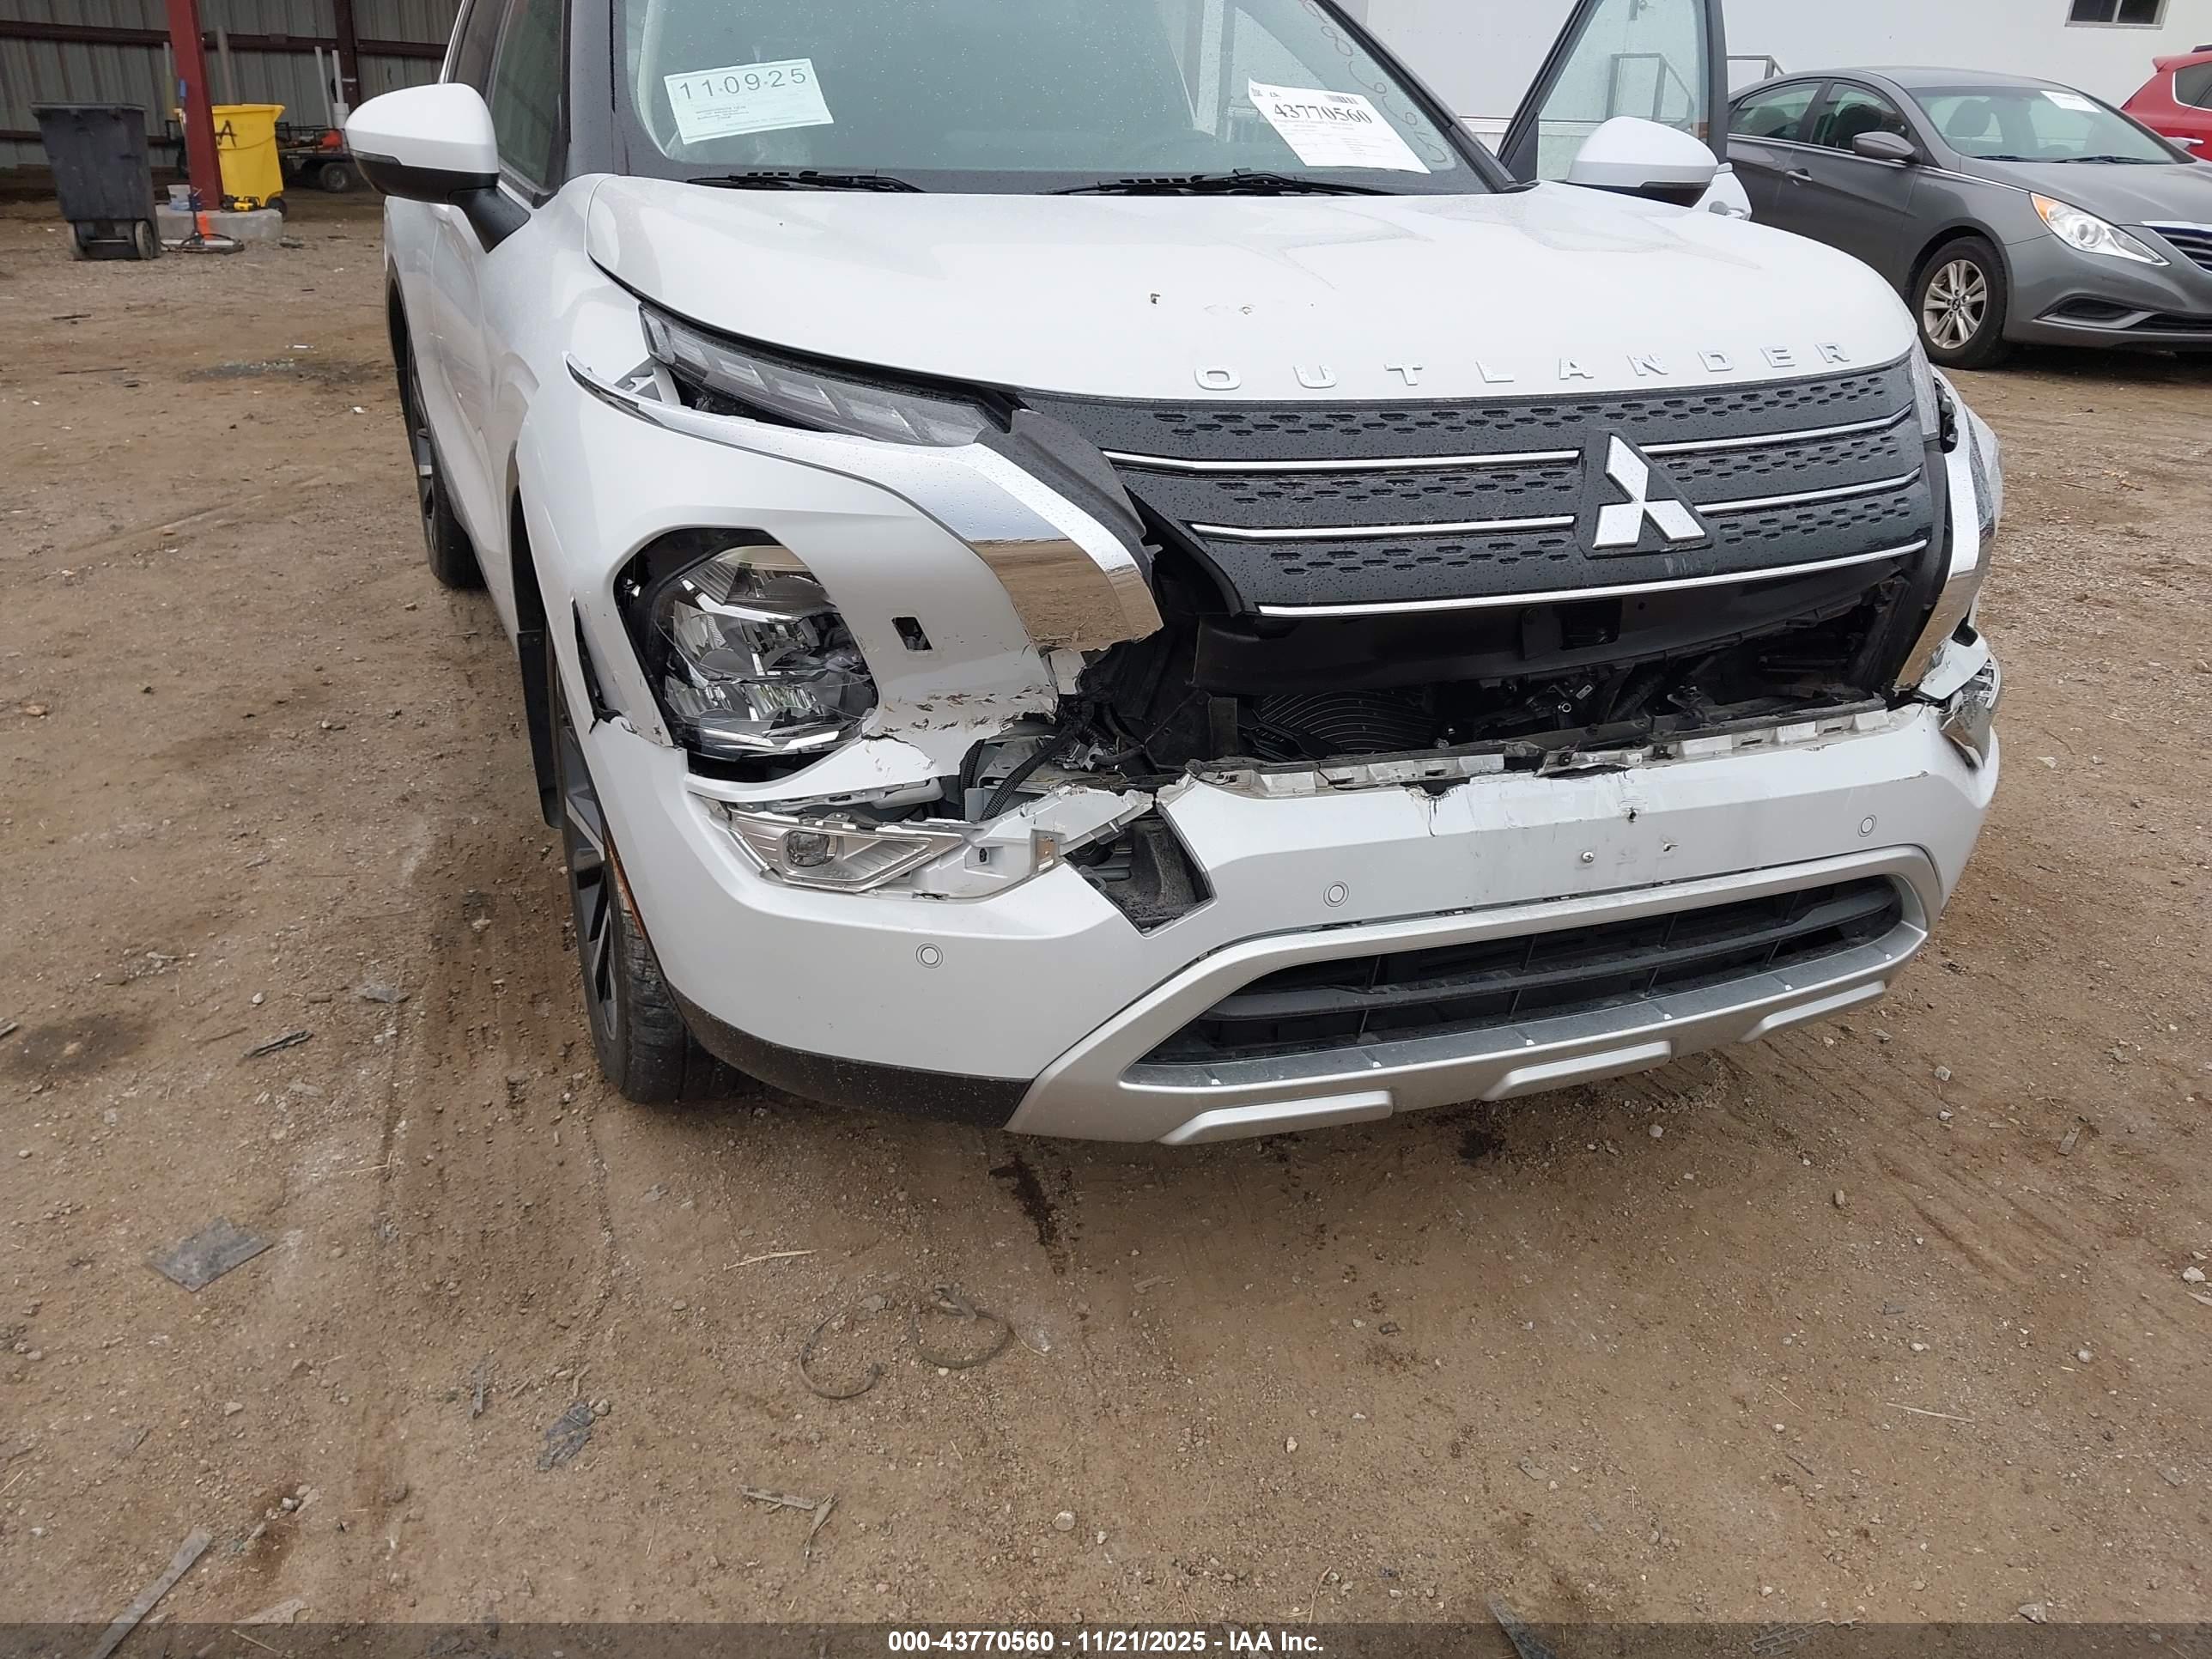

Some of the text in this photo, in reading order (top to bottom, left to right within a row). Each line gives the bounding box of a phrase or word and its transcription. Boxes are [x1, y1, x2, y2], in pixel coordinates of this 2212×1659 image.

[1297, 0, 1449, 163] 98665
[1274, 103, 1373, 124] 43770560
[215, 119, 237, 148] A
[1194, 343, 1850, 391] OUTLANDER
